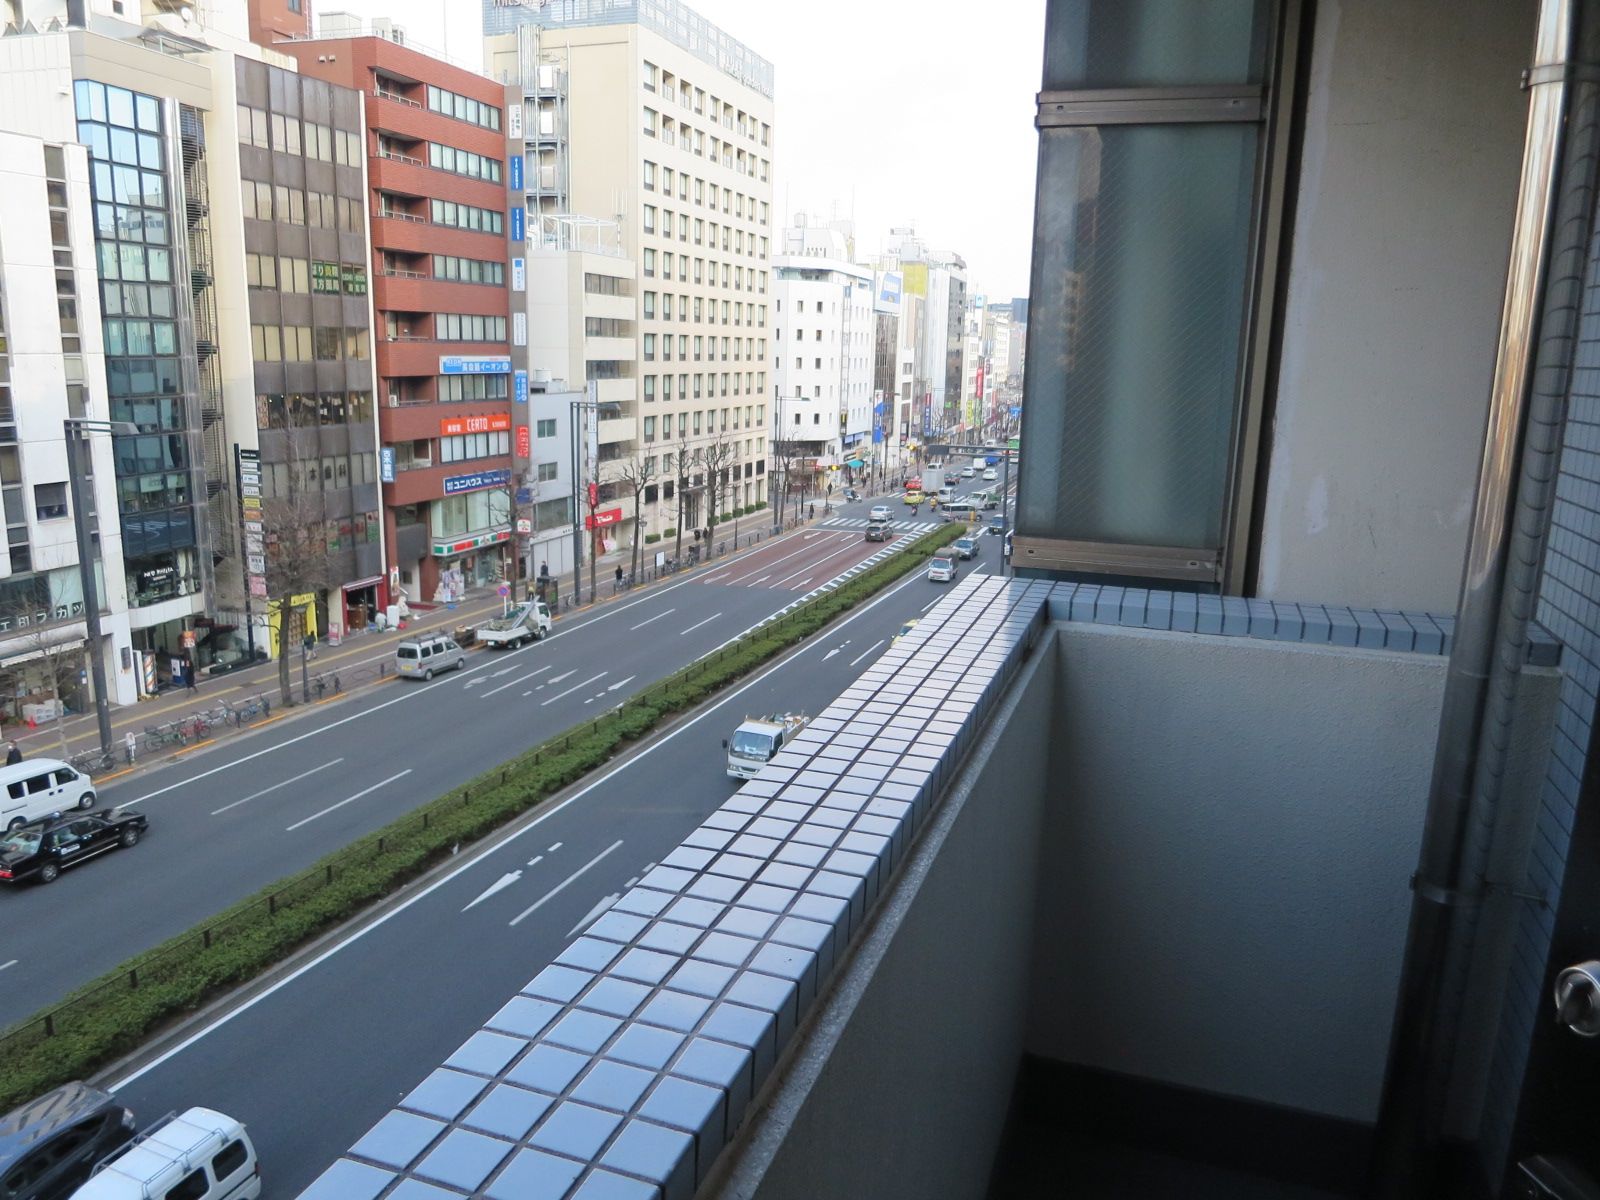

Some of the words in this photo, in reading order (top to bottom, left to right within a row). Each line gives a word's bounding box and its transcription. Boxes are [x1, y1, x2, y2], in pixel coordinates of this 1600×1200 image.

[466, 417, 488, 431] CERTO
[454, 477, 482, 490] ユニハウス
